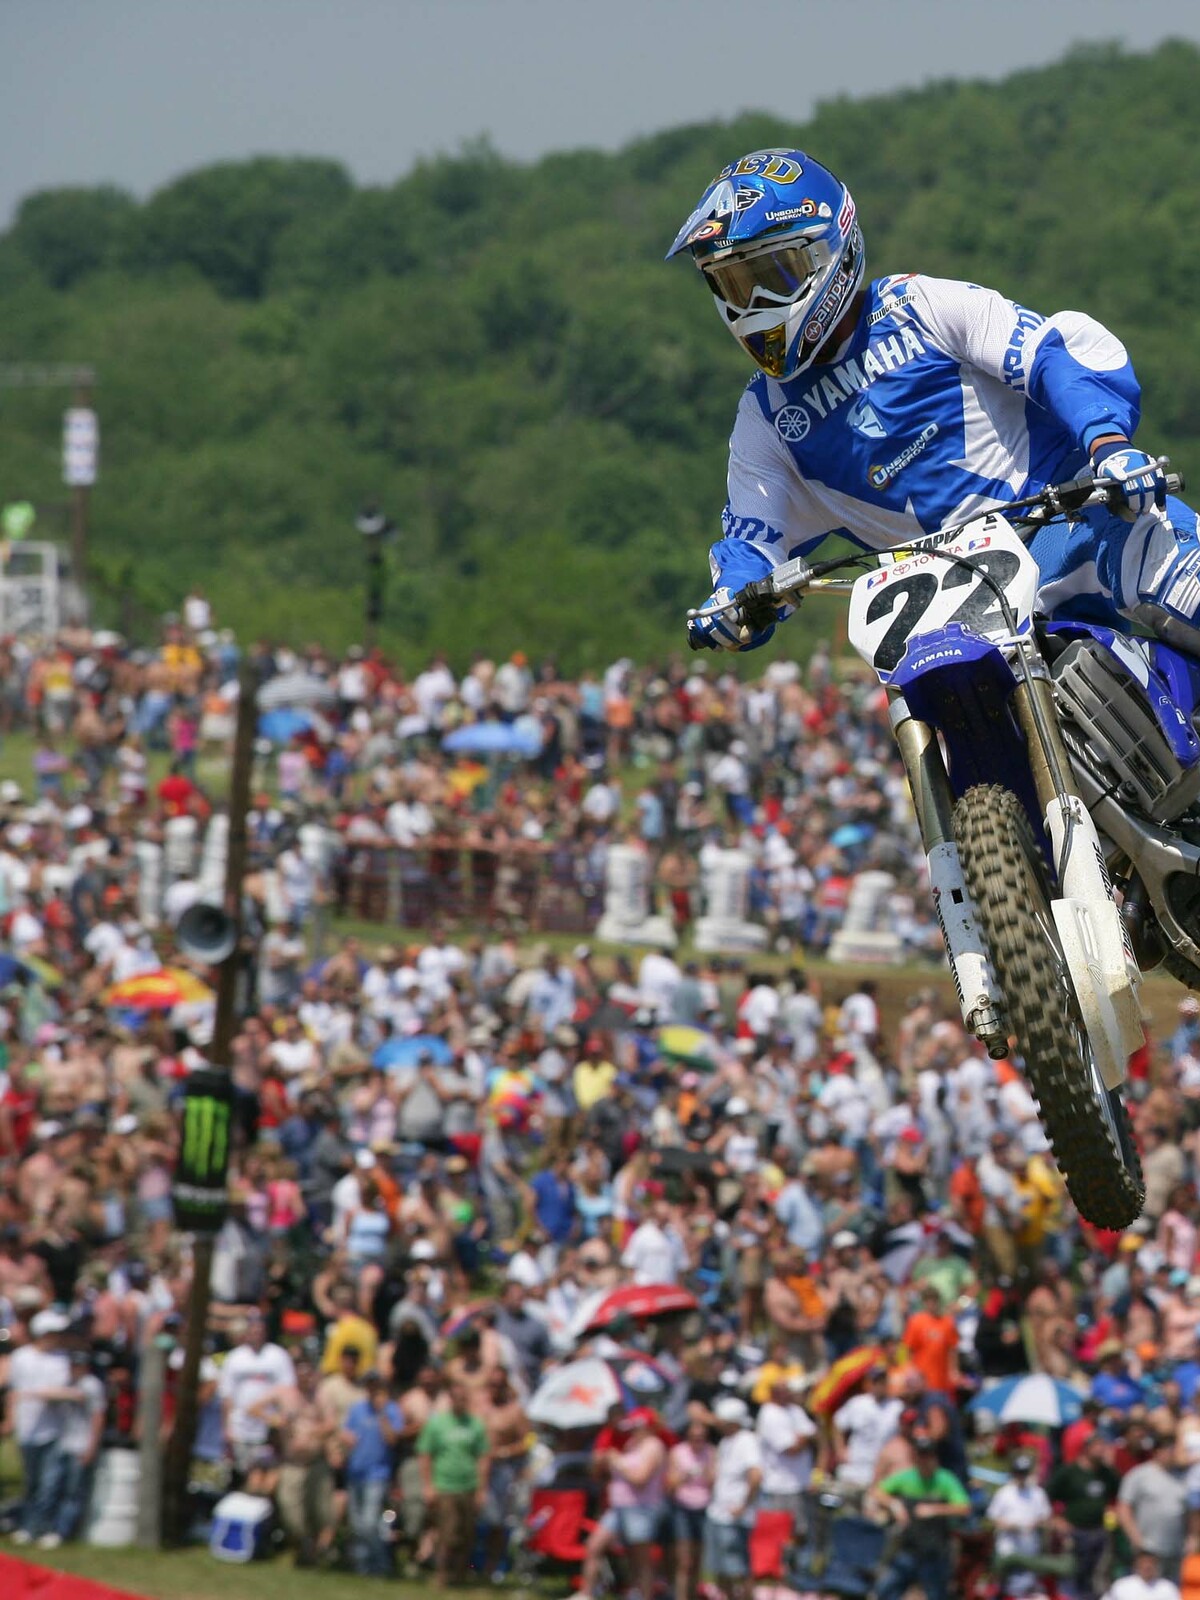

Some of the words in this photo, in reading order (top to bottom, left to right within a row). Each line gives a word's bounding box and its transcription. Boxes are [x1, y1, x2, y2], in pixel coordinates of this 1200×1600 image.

[765, 204, 813, 221] UNBOUND
[775, 213, 803, 222] ENERGY
[803, 323, 926, 419] YAMAHA
[873, 423, 939, 485] UNBOUND
[889, 442, 926, 478] ENERGY
[866, 550, 1021, 671] 22
[910, 648, 963, 671] YAMAHA
